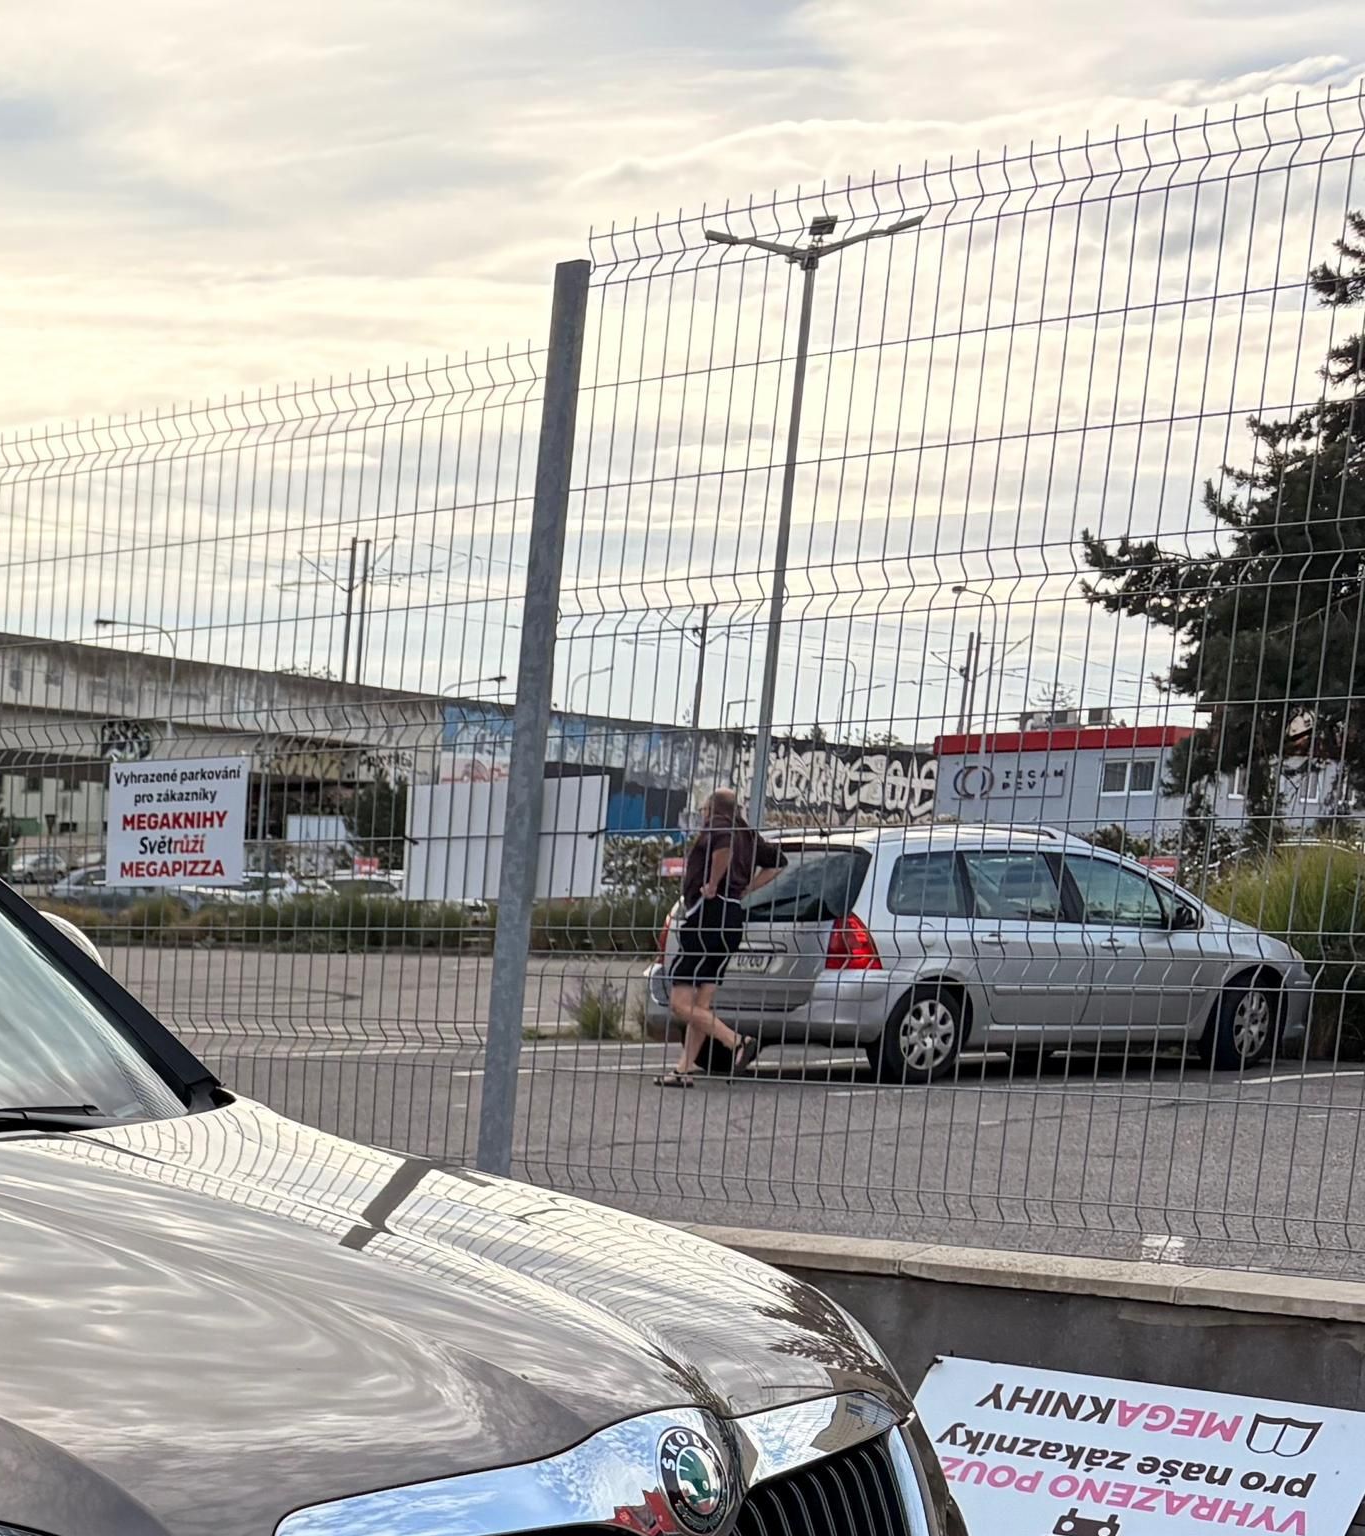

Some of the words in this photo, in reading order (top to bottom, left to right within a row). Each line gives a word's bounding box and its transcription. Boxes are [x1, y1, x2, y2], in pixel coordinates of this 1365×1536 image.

[114, 768, 178, 787] Vyhrazené
[179, 765, 242, 785] parkování
[134, 791, 154, 806] pro
[156, 787, 218, 804] zákazníky
[122, 810, 228, 831] MEGAKNIHY
[120, 859, 225, 878] MEGAPIZZA
[975, 1383, 1245, 1443] MEGAKNIHY
[935, 1422, 1131, 1474] zákazníky
[1136, 1454, 1235, 1486] naše
[1240, 1469, 1317, 1499] pro
[1048, 1474, 1307, 1536] VYHRAZENO
